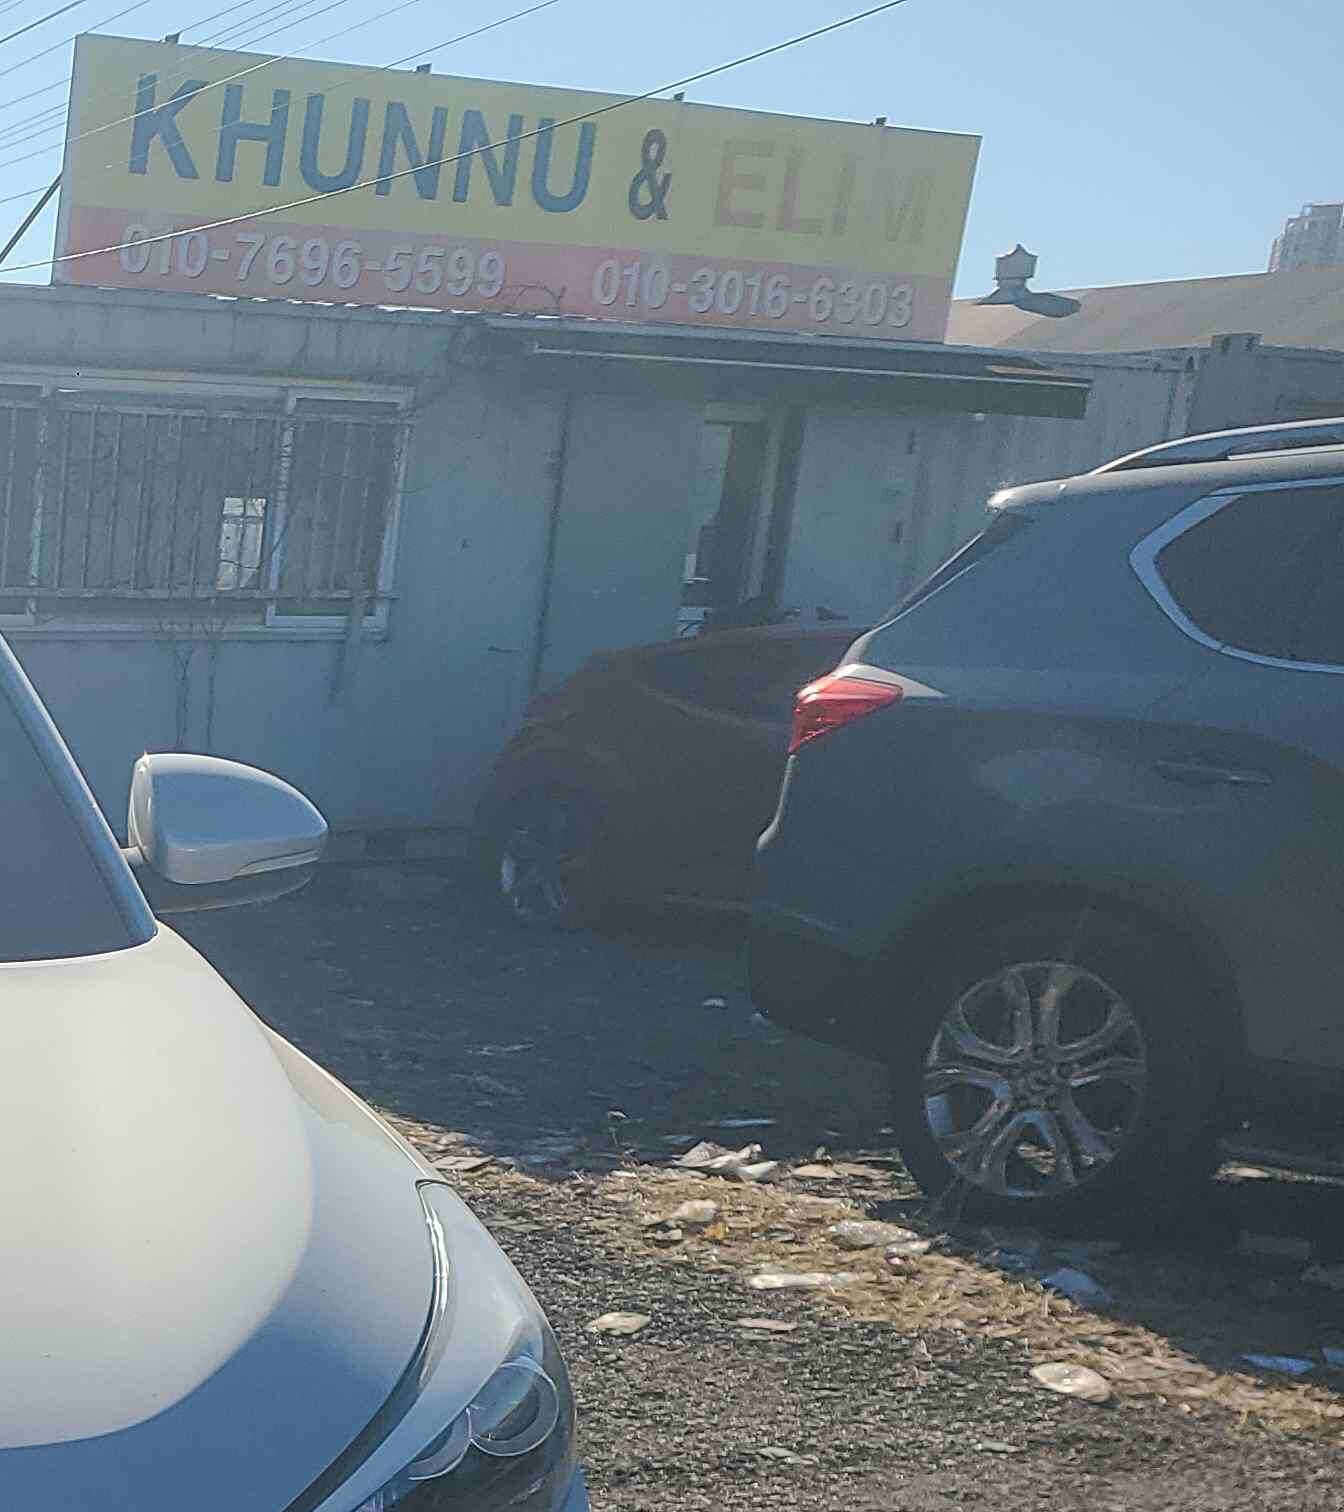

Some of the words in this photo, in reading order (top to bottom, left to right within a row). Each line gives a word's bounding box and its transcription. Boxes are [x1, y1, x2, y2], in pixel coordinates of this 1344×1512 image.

[129, 73, 597, 213] KHUNNU
[628, 128, 673, 220] &
[119, 223, 508, 299] 010-7696-5599
[592, 258, 913, 328] 010-3016-6303
